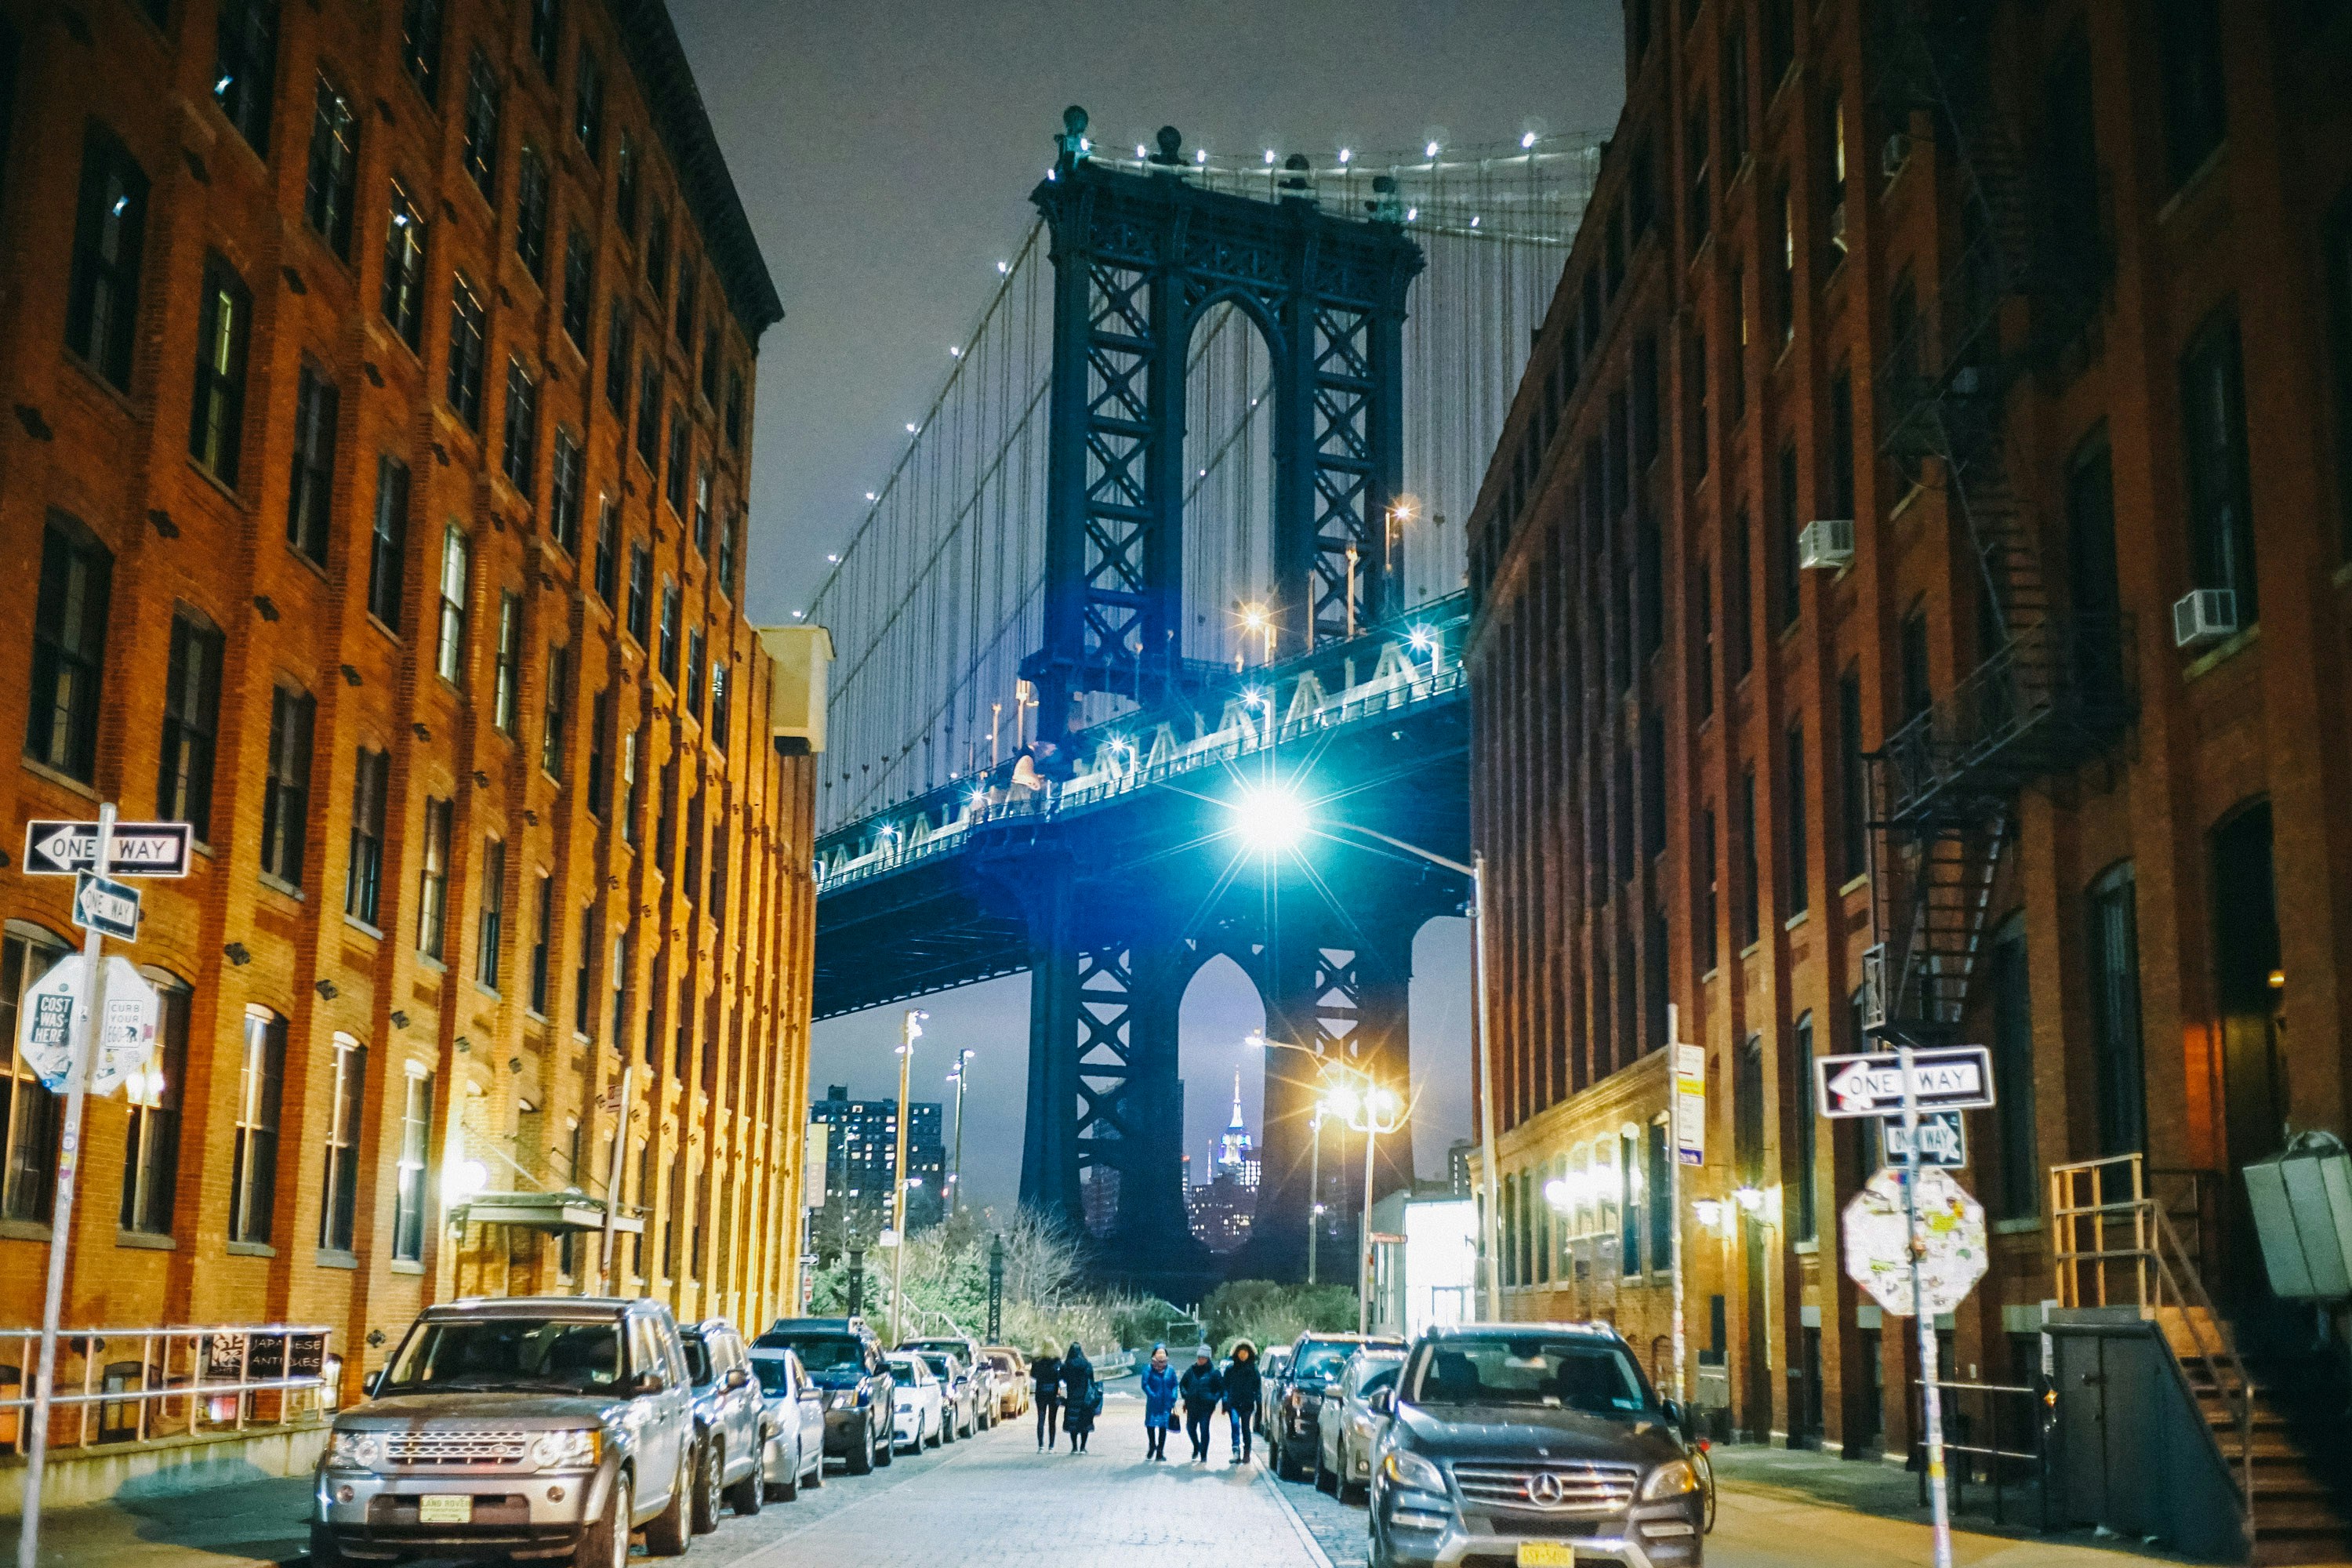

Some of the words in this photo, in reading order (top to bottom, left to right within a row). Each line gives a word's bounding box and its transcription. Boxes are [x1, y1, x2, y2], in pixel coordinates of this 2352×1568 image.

[53, 838, 96, 858] ONE
[119, 840, 167, 859] WAY
[85, 890, 103, 915] ONE
[111, 898, 131, 922] WAY
[41, 996, 71, 1012] COST
[40, 1012, 64, 1027] WAS
[34, 1028, 64, 1043] HERE
[1850, 1075, 1895, 1095] ONE
[1919, 1068, 1965, 1089] WAY
[1926, 1129, 1949, 1149] WAY
[251, 1338, 321, 1350] JAPAESE
